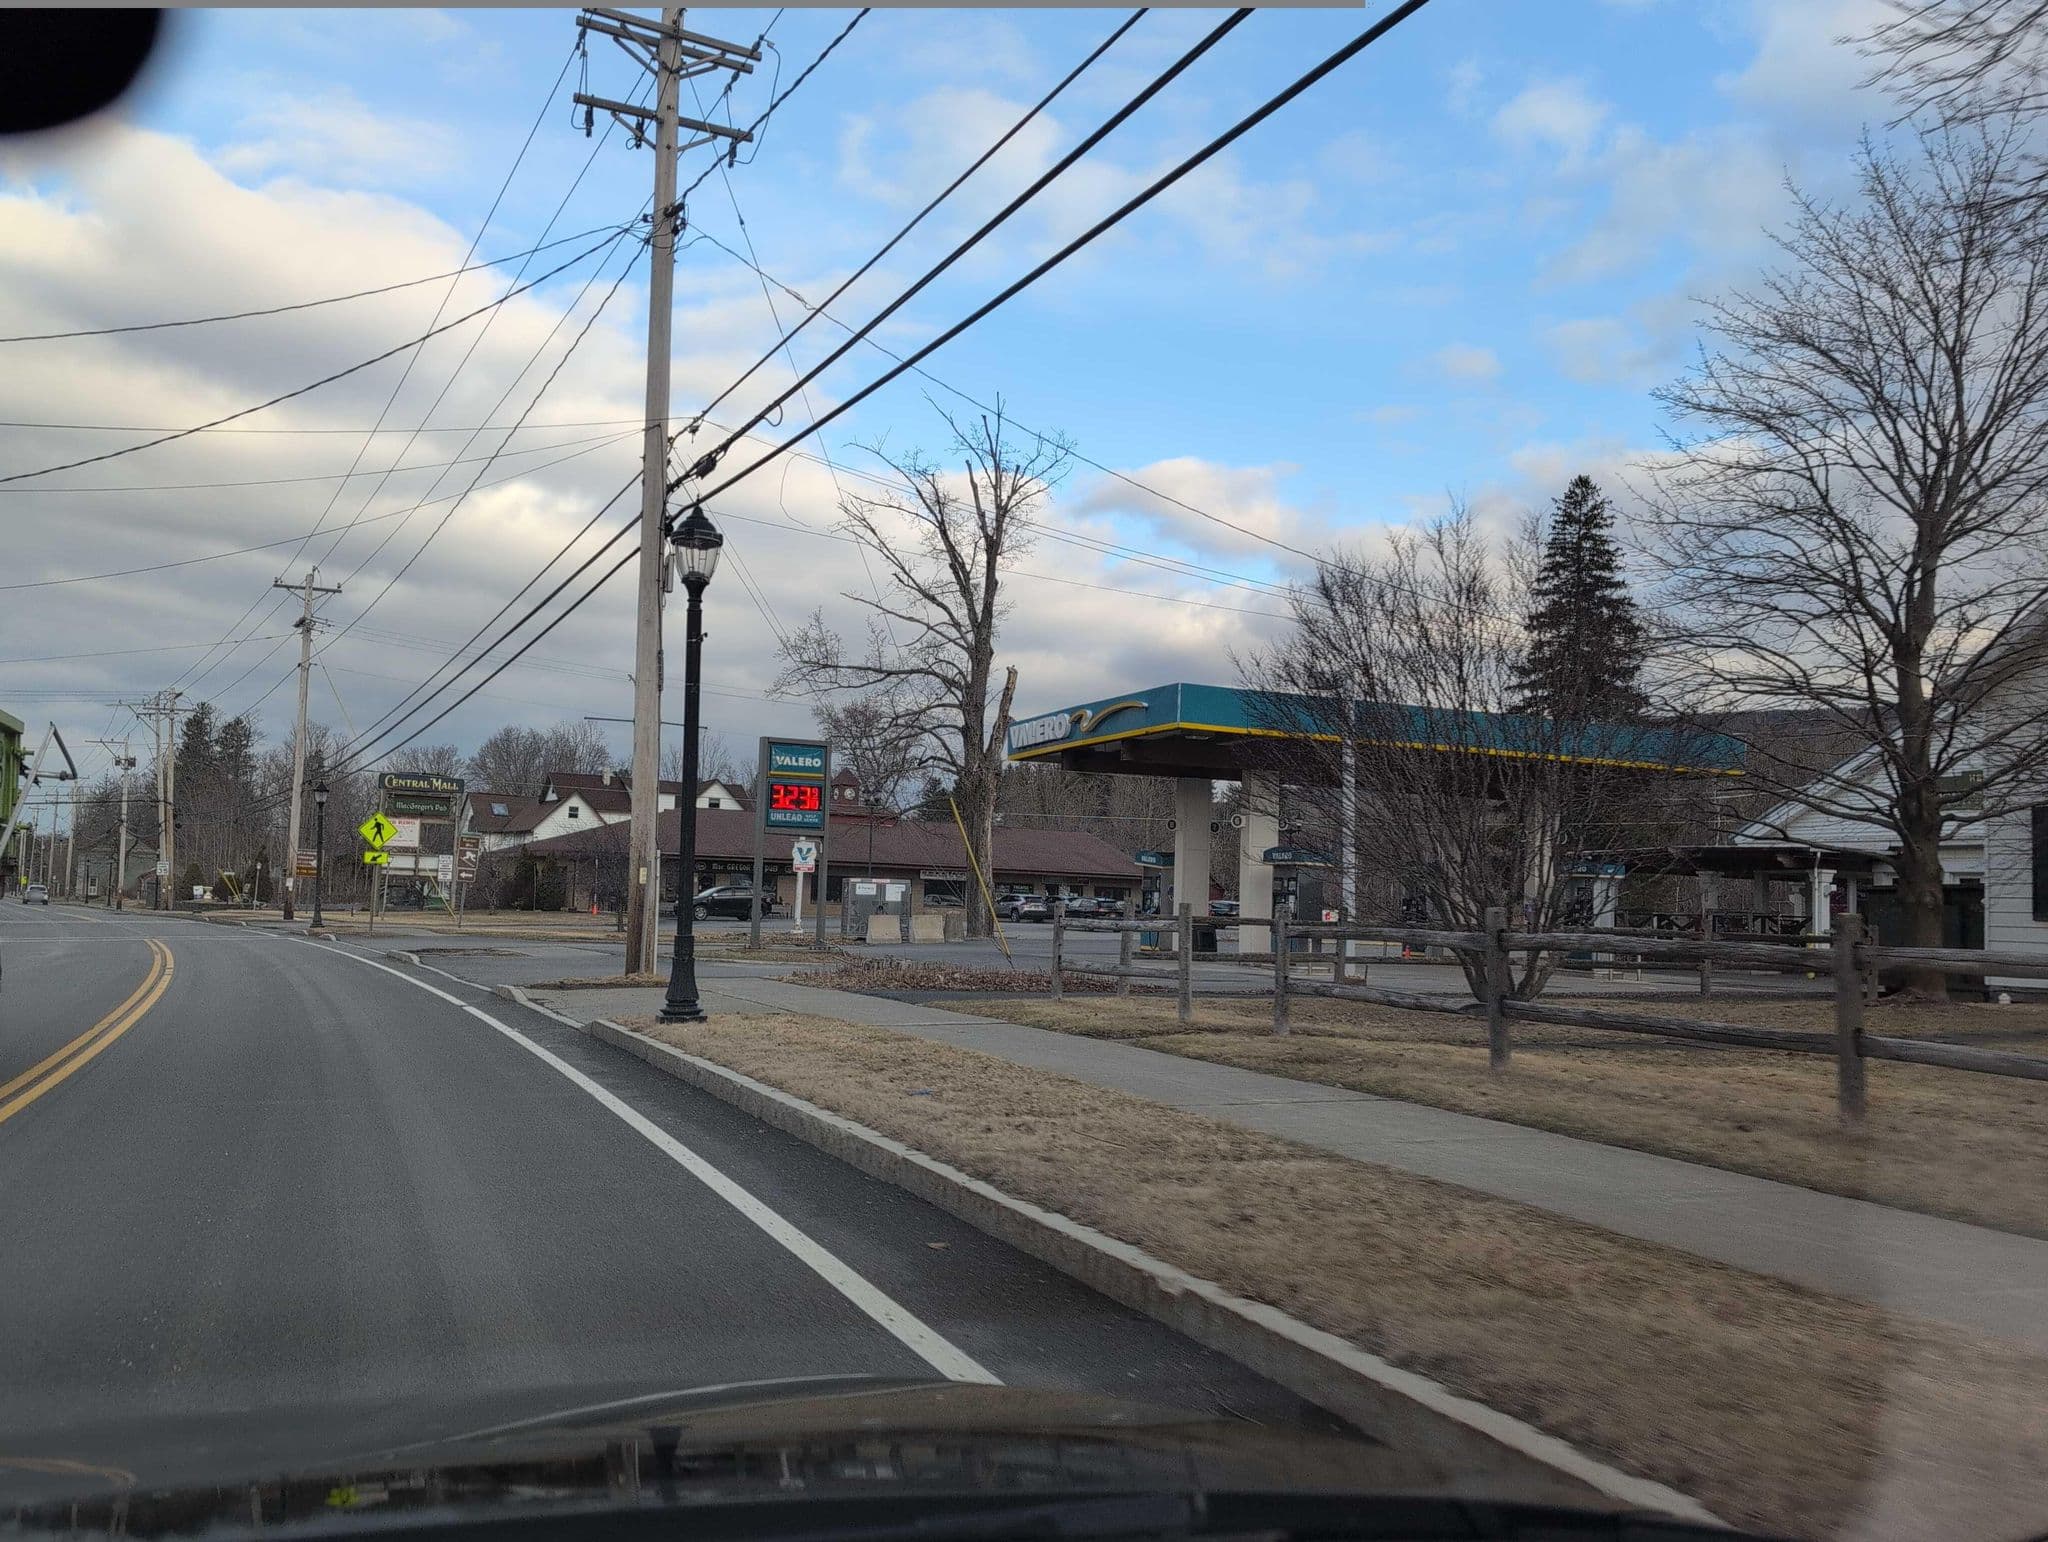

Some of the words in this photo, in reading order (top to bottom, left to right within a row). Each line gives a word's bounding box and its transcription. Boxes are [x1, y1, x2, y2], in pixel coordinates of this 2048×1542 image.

[1010, 713, 1071, 749] VALERO
[776, 755, 822, 768] VALERO
[385, 774, 430, 788] CENTRAL
[430, 777, 459, 791] MALL
[770, 812, 803, 822] UNLEAD
